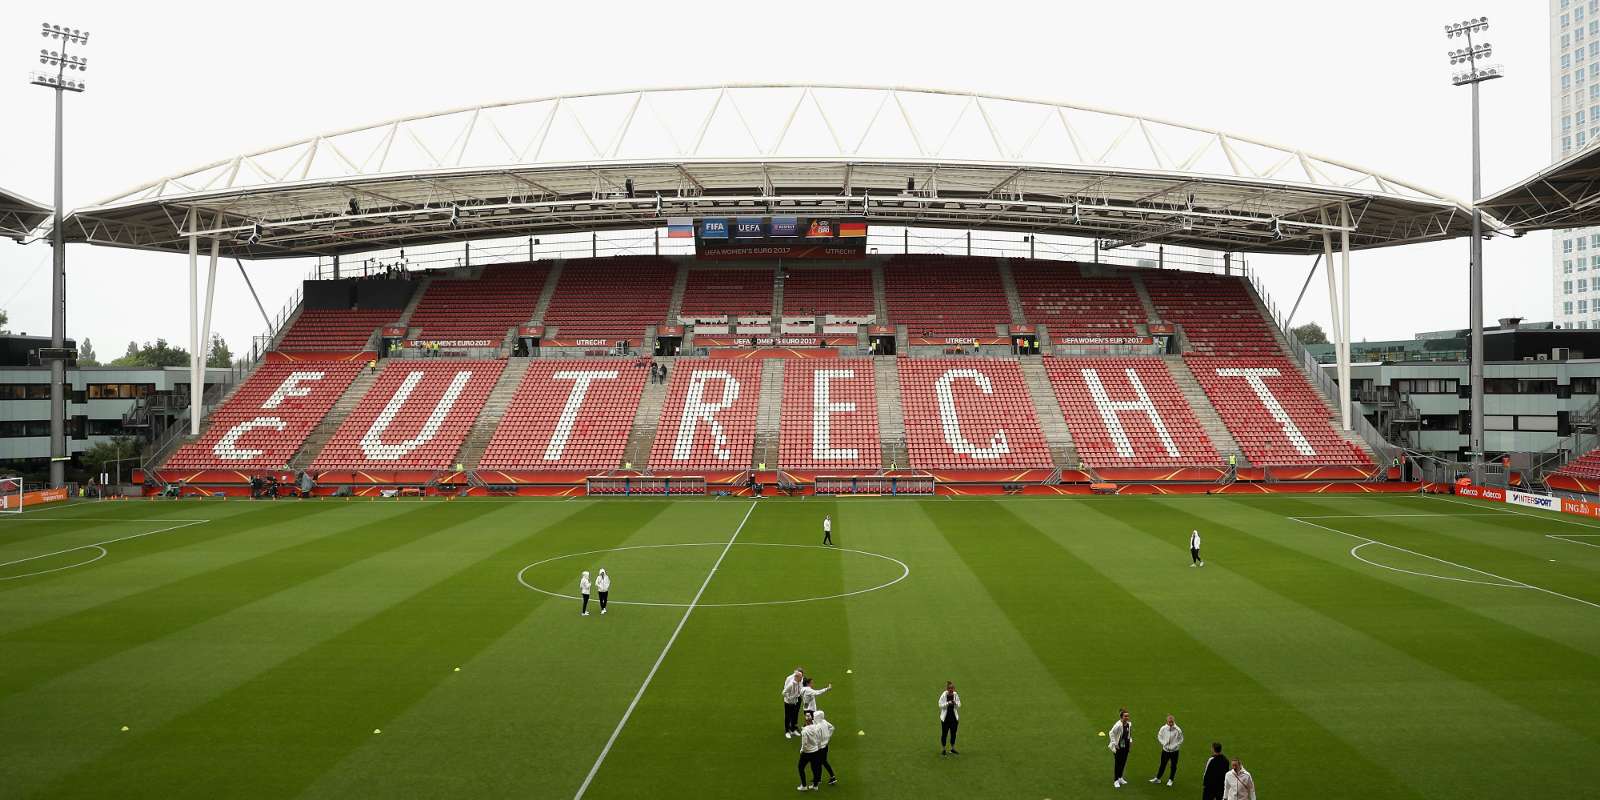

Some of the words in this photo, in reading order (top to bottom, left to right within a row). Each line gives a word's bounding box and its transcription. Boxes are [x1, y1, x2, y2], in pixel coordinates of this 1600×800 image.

[720, 247, 753, 255] WOMEN'S
[825, 247, 857, 255] UTRECHT
[359, 368, 1316, 461] UTRECHT
[1565, 502, 1579, 513] ING
